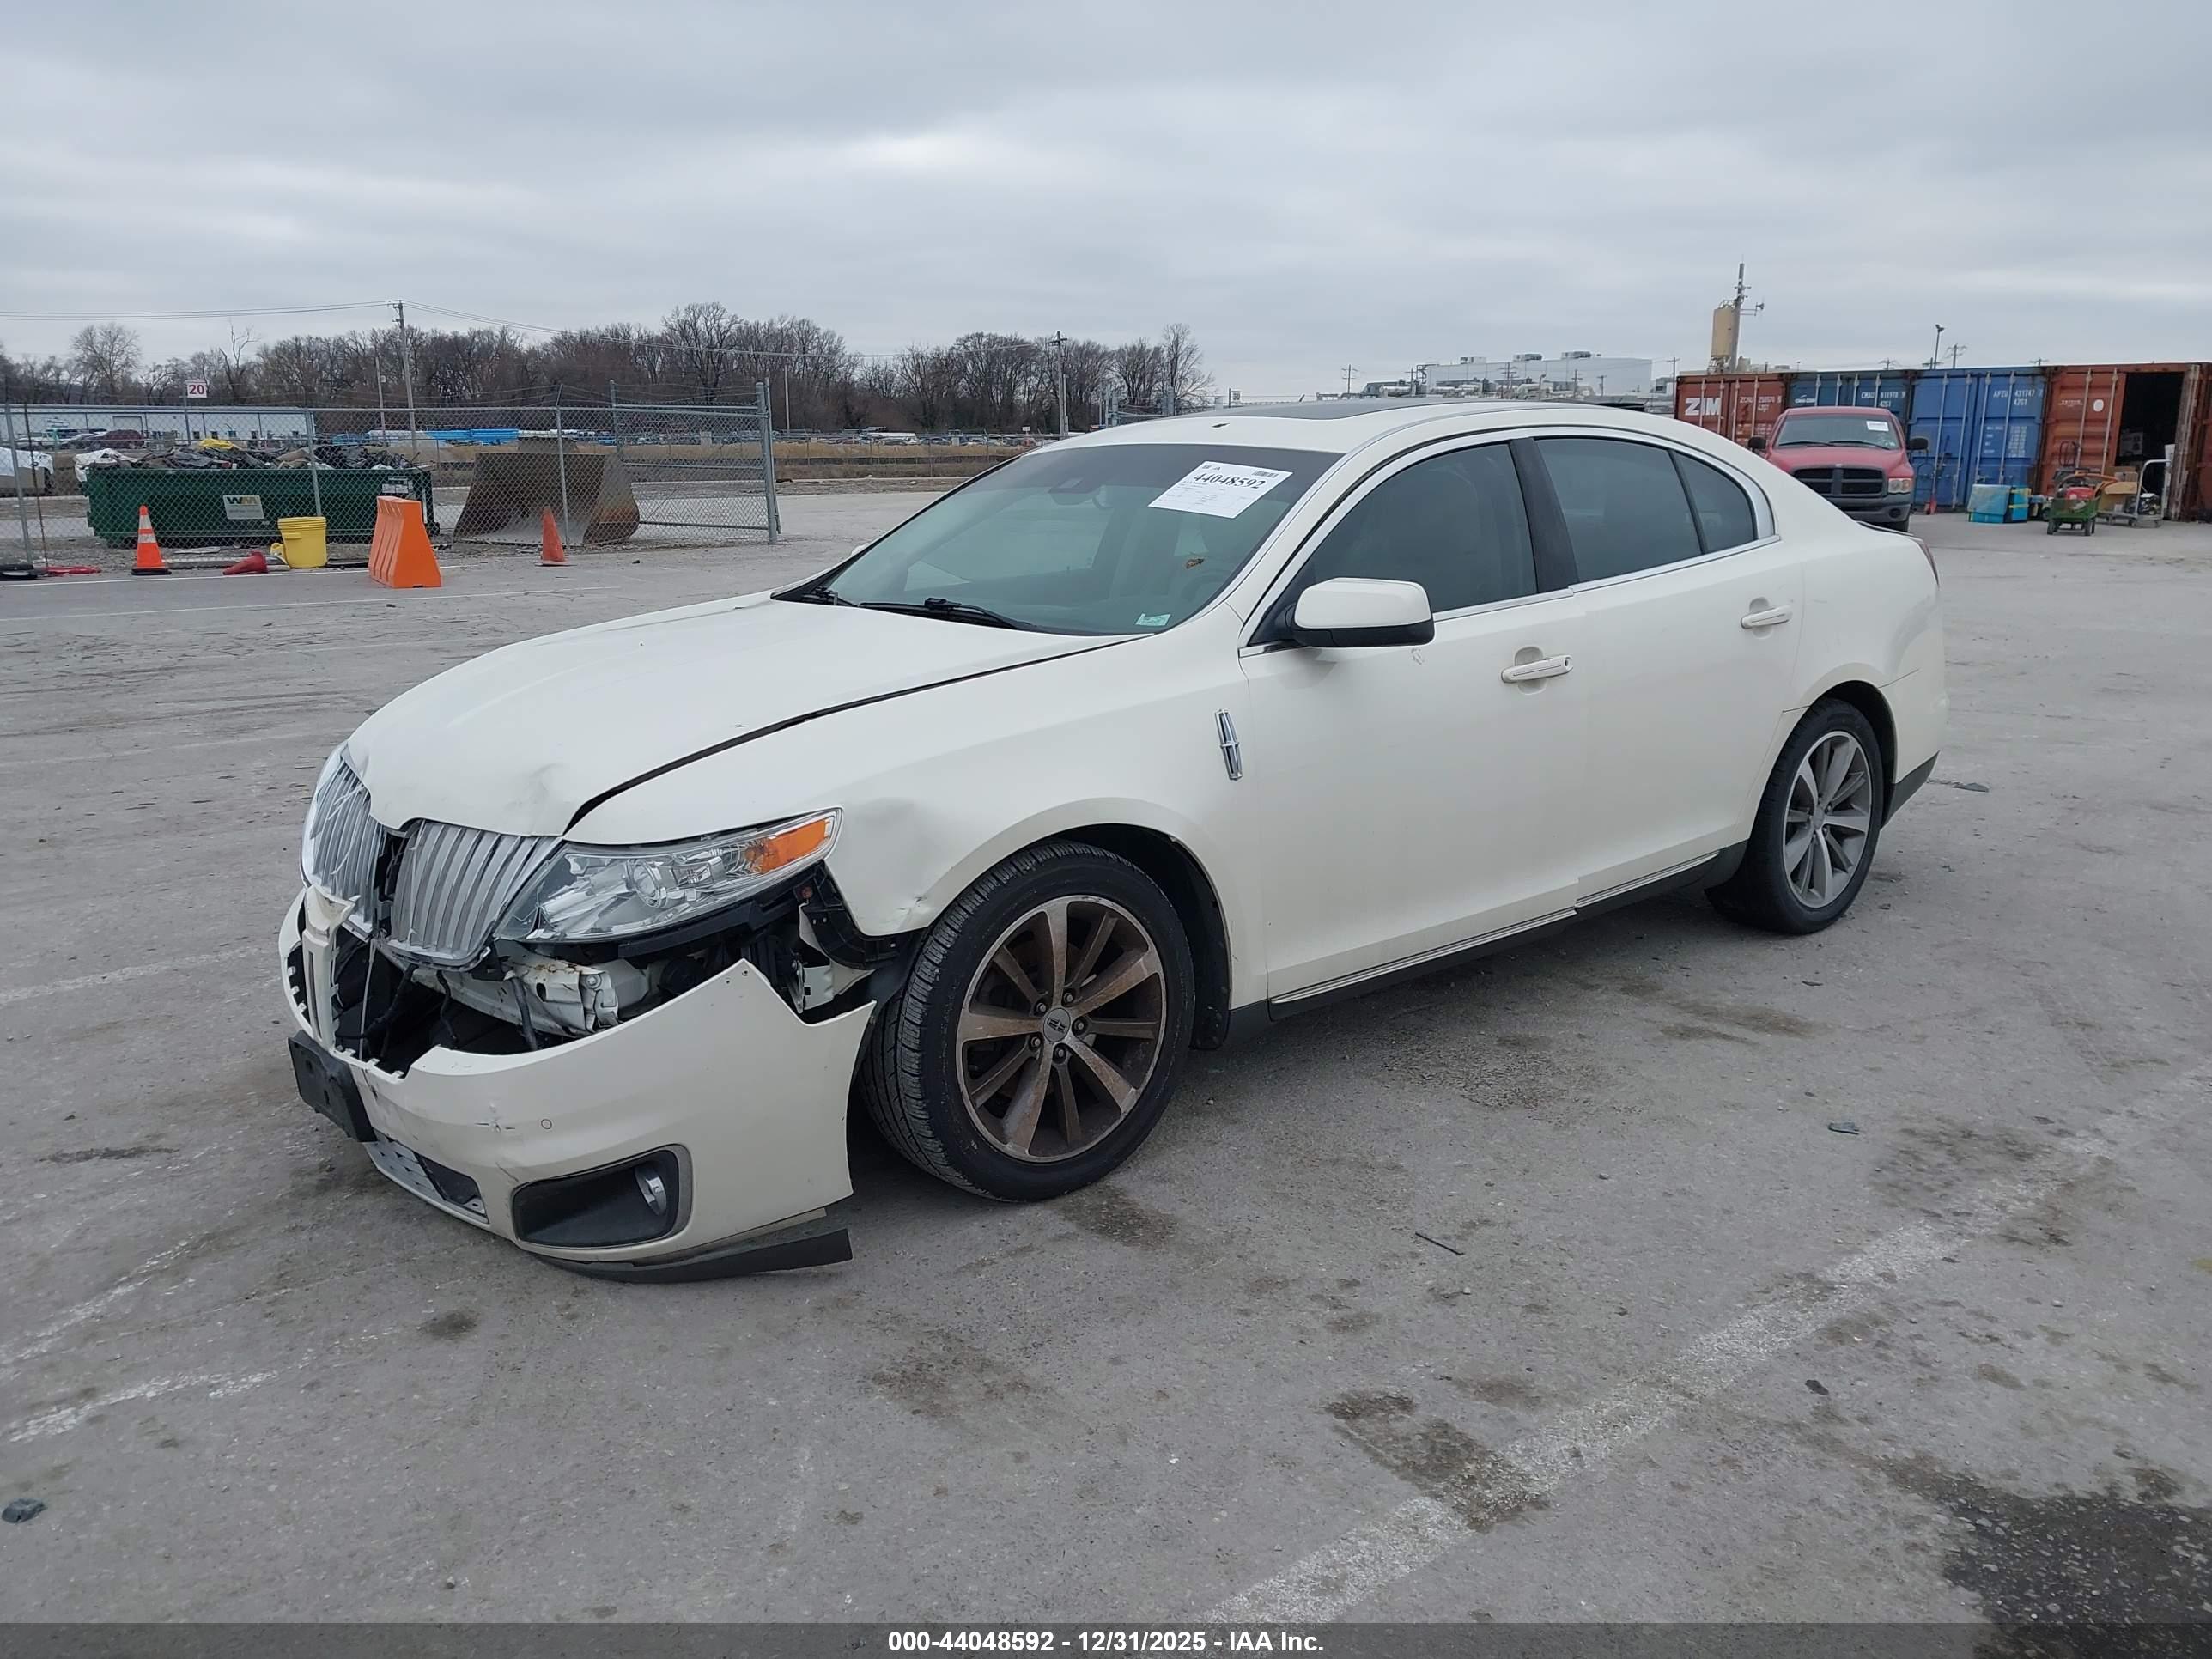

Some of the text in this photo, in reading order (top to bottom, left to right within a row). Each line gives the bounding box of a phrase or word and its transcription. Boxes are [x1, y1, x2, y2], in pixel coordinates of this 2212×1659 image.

[189, 384, 204, 394] 20
[1685, 398, 1721, 416] ZIM
[1194, 473, 1266, 489] 44048592
